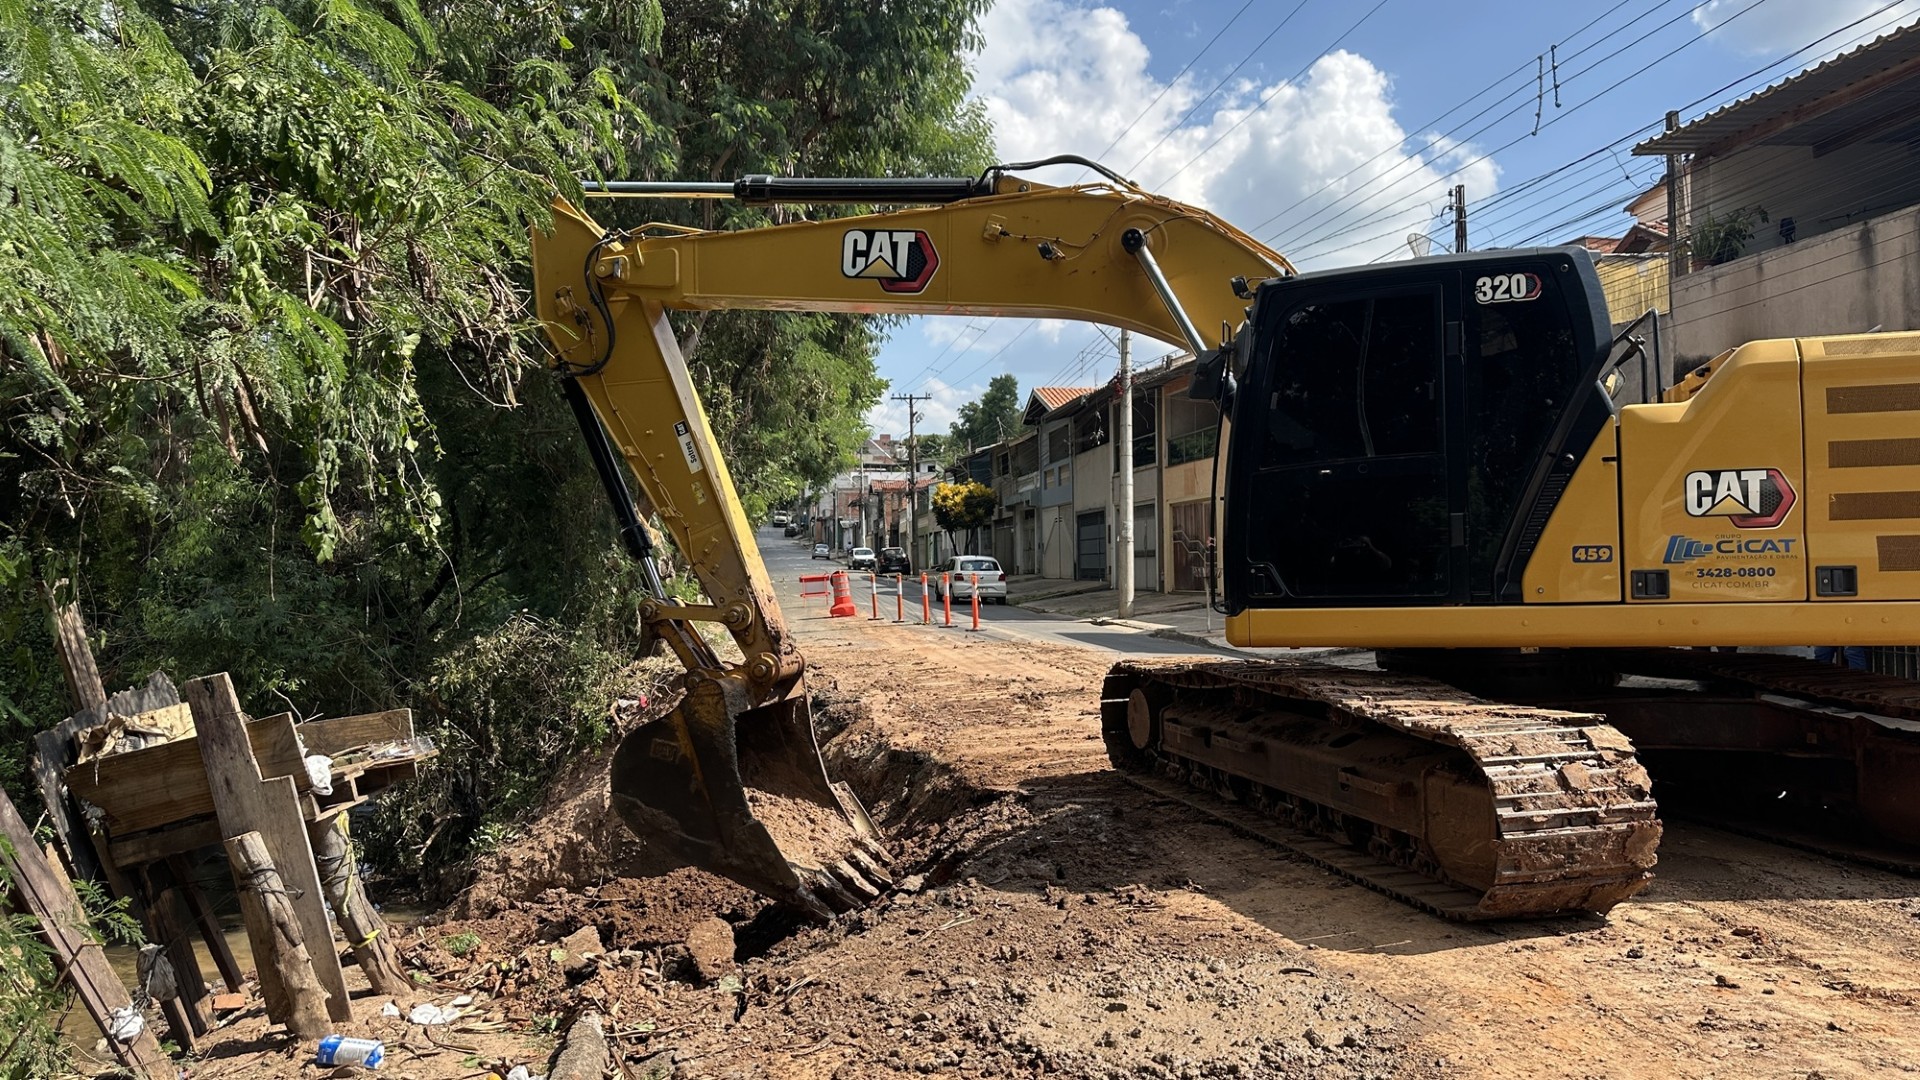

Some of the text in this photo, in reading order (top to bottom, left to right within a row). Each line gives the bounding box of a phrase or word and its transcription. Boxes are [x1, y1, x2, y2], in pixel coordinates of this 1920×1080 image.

[843, 230, 915, 278] CAT
[1475, 273, 1526, 301] 320
[1686, 470, 1767, 516] CAT
[1574, 548, 1610, 560] 459
[1696, 567, 1776, 578] 3428-0800
